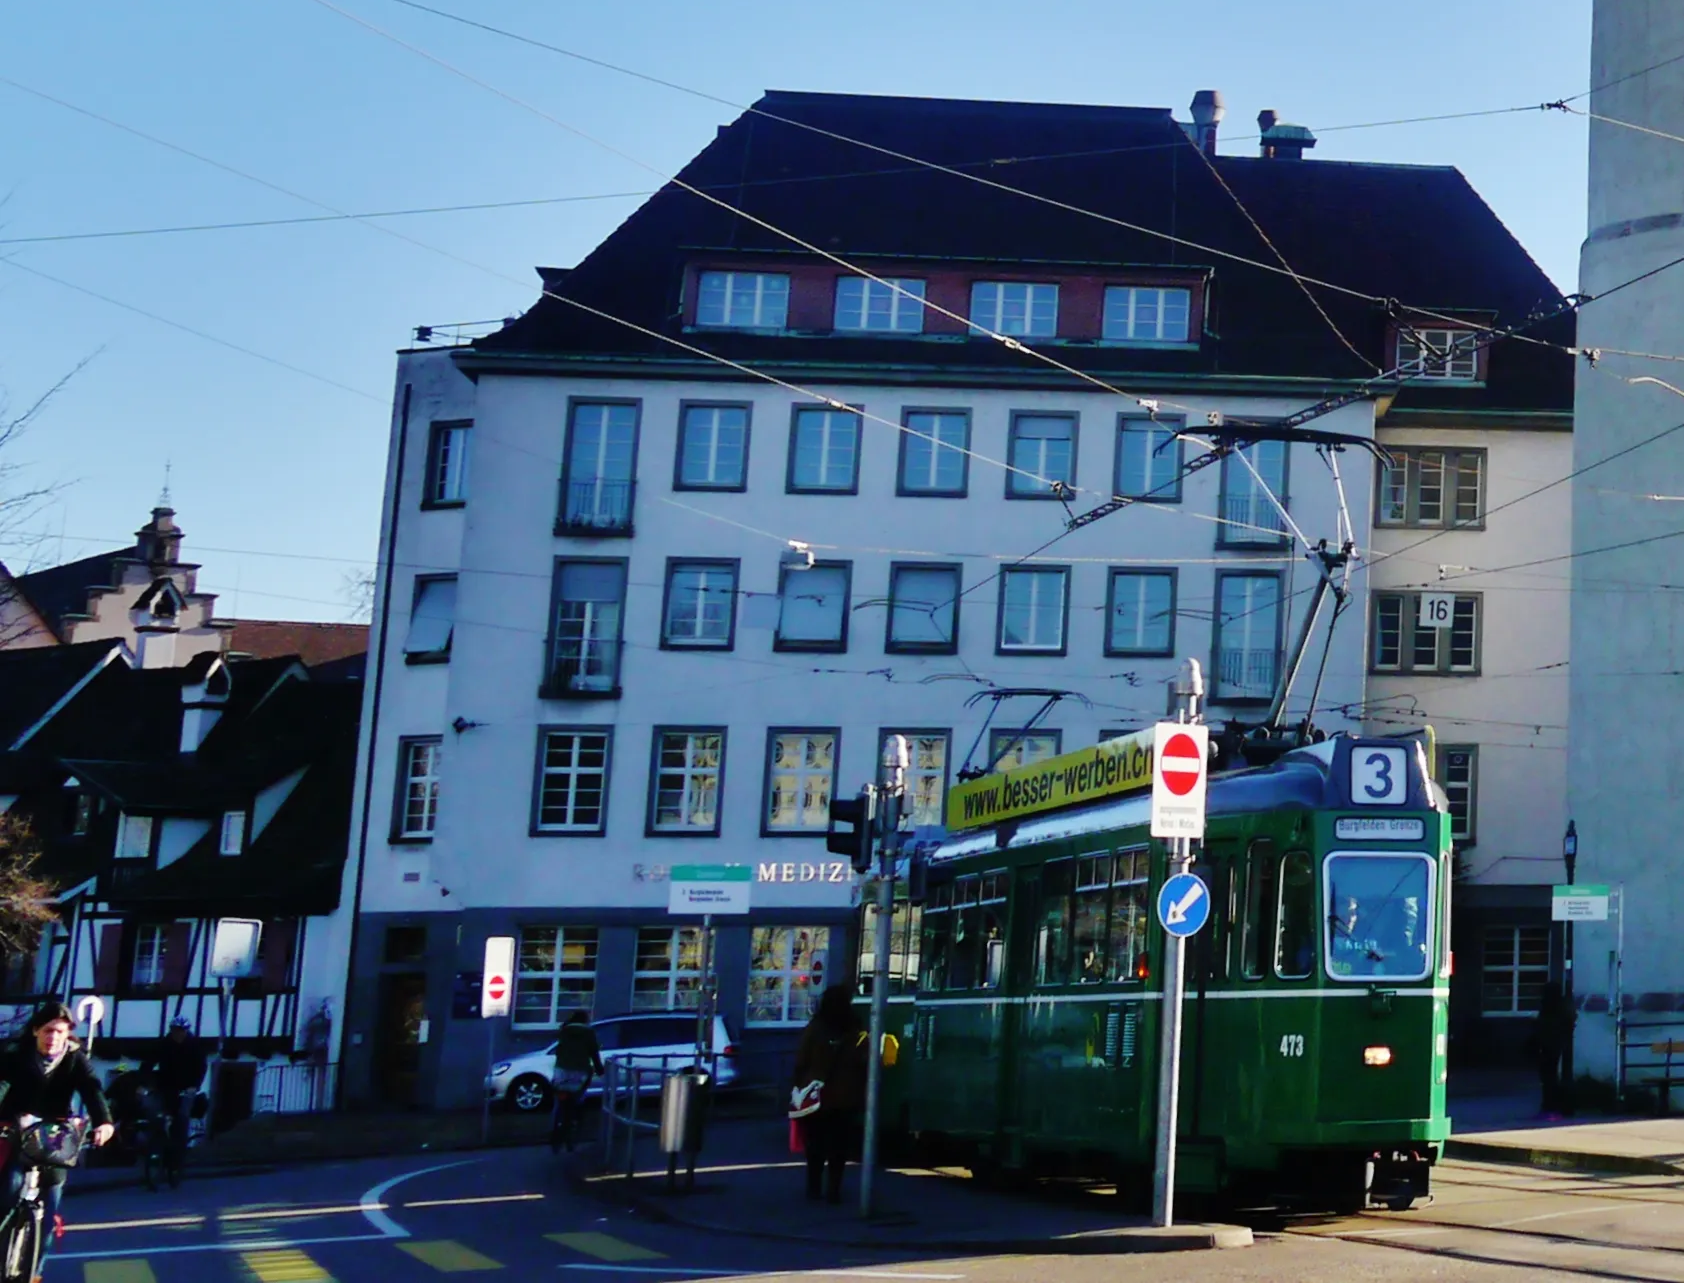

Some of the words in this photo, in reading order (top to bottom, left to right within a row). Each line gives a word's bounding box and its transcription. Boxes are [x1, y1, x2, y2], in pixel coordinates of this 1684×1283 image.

[1428, 599, 1449, 621] 16
[1364, 753, 1393, 798] 3
[1279, 1034, 1304, 1057] 473
